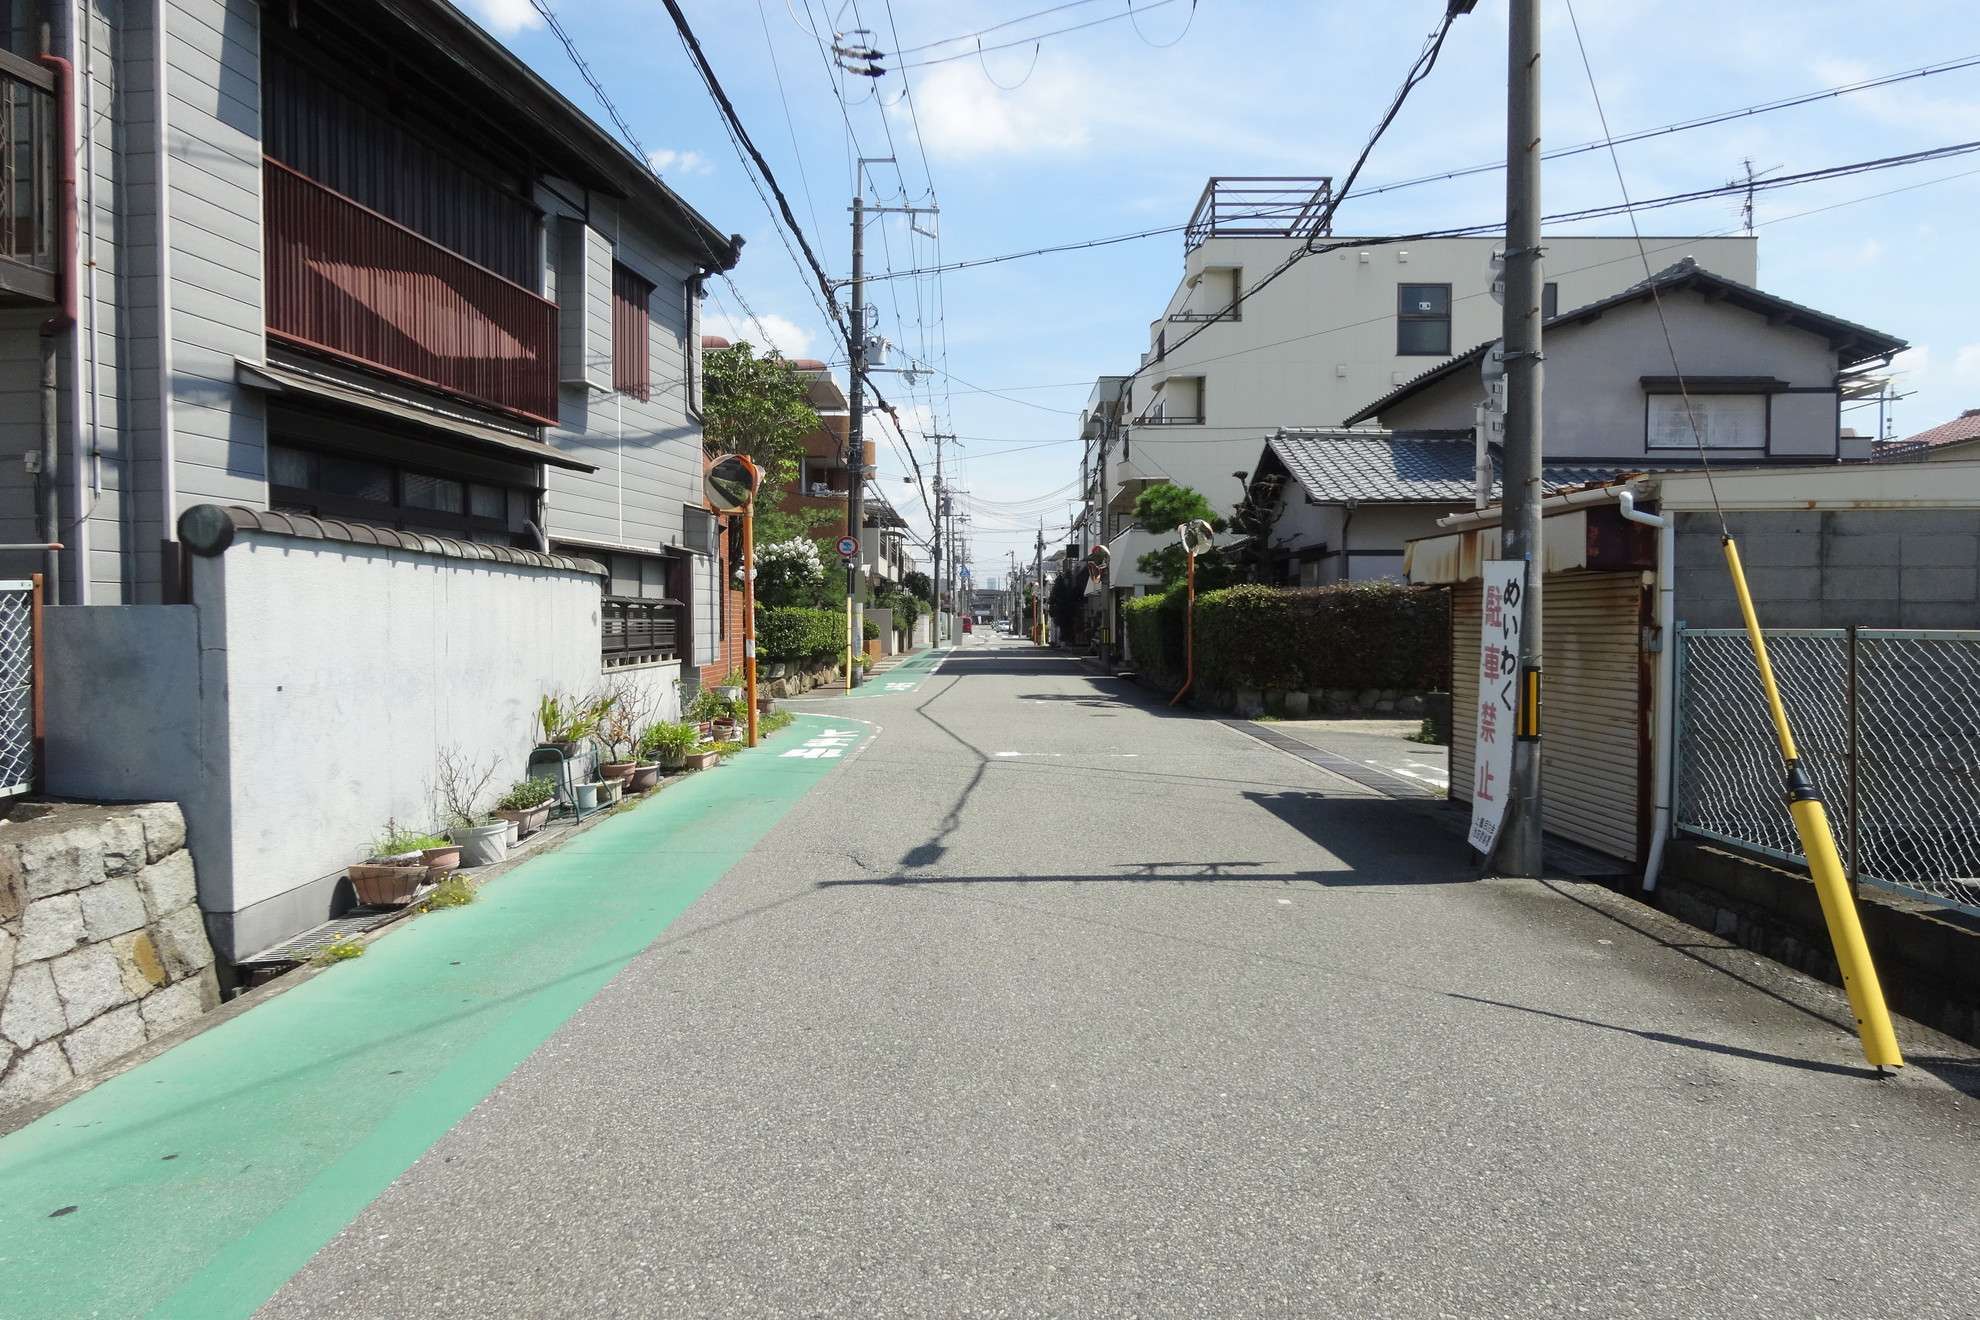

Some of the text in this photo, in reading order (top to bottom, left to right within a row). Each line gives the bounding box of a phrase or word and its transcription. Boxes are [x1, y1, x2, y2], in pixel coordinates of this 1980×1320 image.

[1477, 585, 1503, 802] 駐車禁止
[1500, 578, 1520, 711] めいわく
